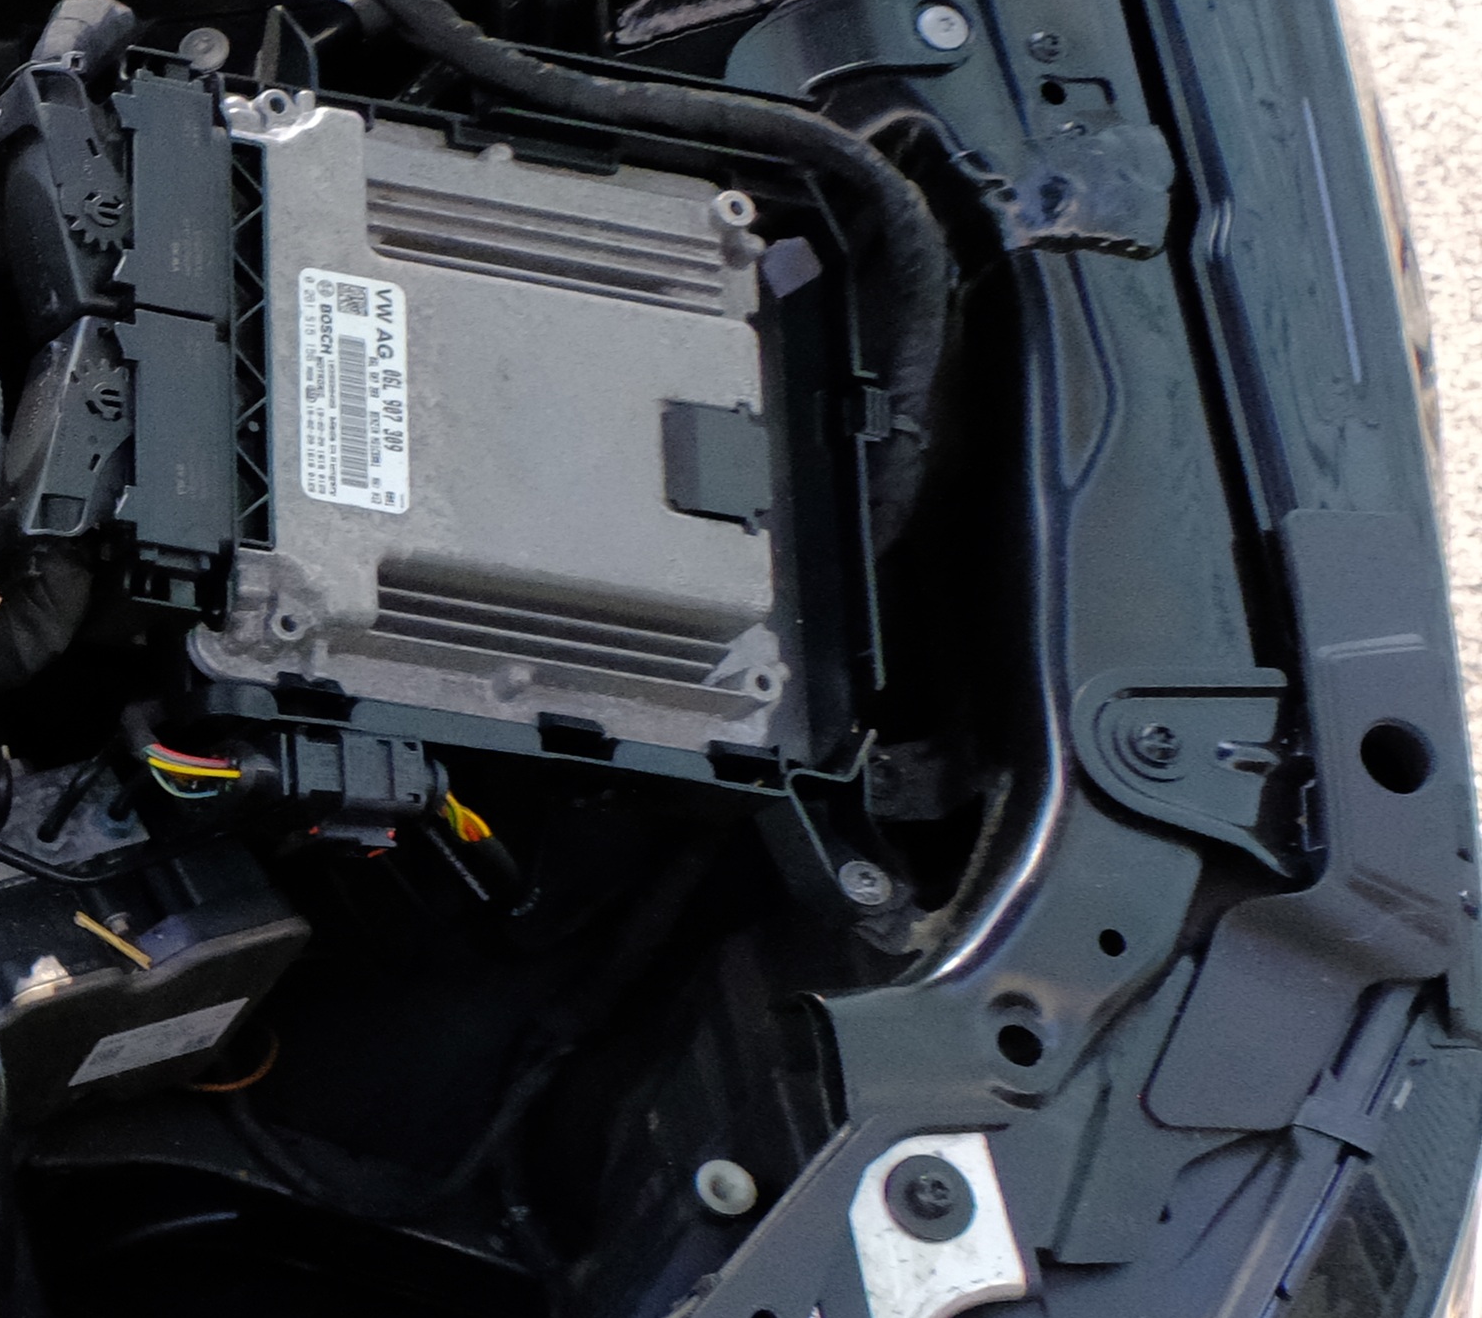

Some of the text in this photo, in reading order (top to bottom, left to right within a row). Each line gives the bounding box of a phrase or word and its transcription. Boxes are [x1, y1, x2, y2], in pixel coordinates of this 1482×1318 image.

[375, 289, 393, 324] VW
[320, 303, 333, 355] BOSCH
[376, 328, 394, 360] AG
[382, 399, 403, 423] 907
[382, 428, 404, 453] 309
